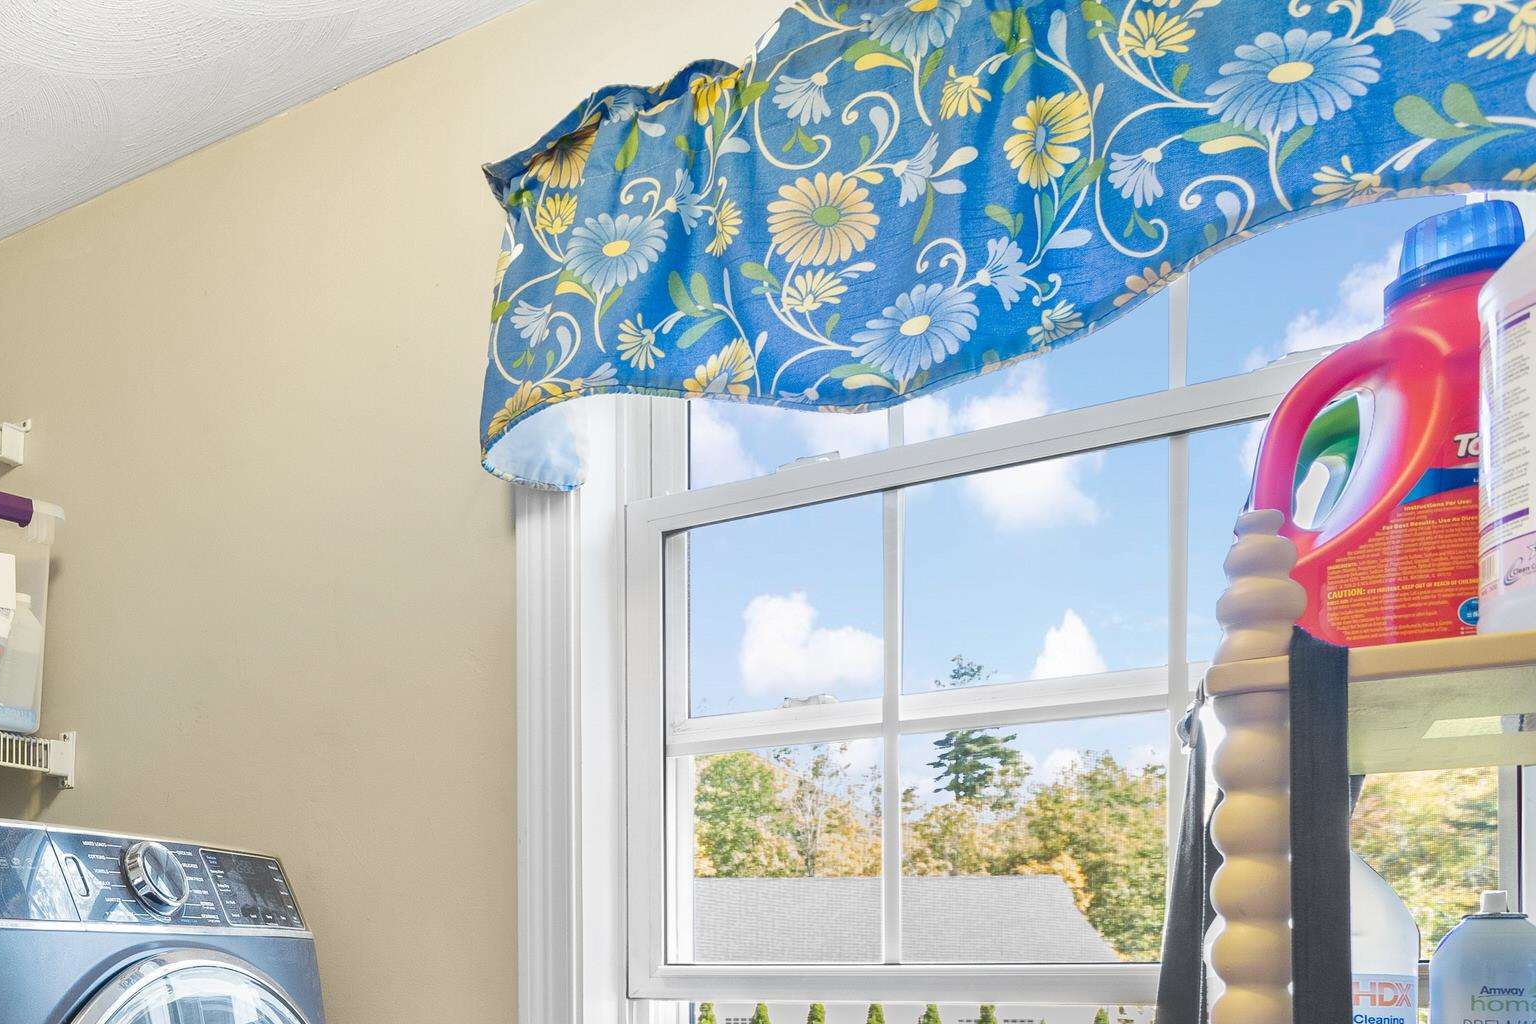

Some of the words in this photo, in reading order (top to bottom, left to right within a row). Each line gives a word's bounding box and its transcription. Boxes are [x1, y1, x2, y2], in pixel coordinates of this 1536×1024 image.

[1327, 587, 1366, 600] CAUTION:
[1352, 981, 1412, 1008] HDX
[1479, 985, 1525, 997] Amway
